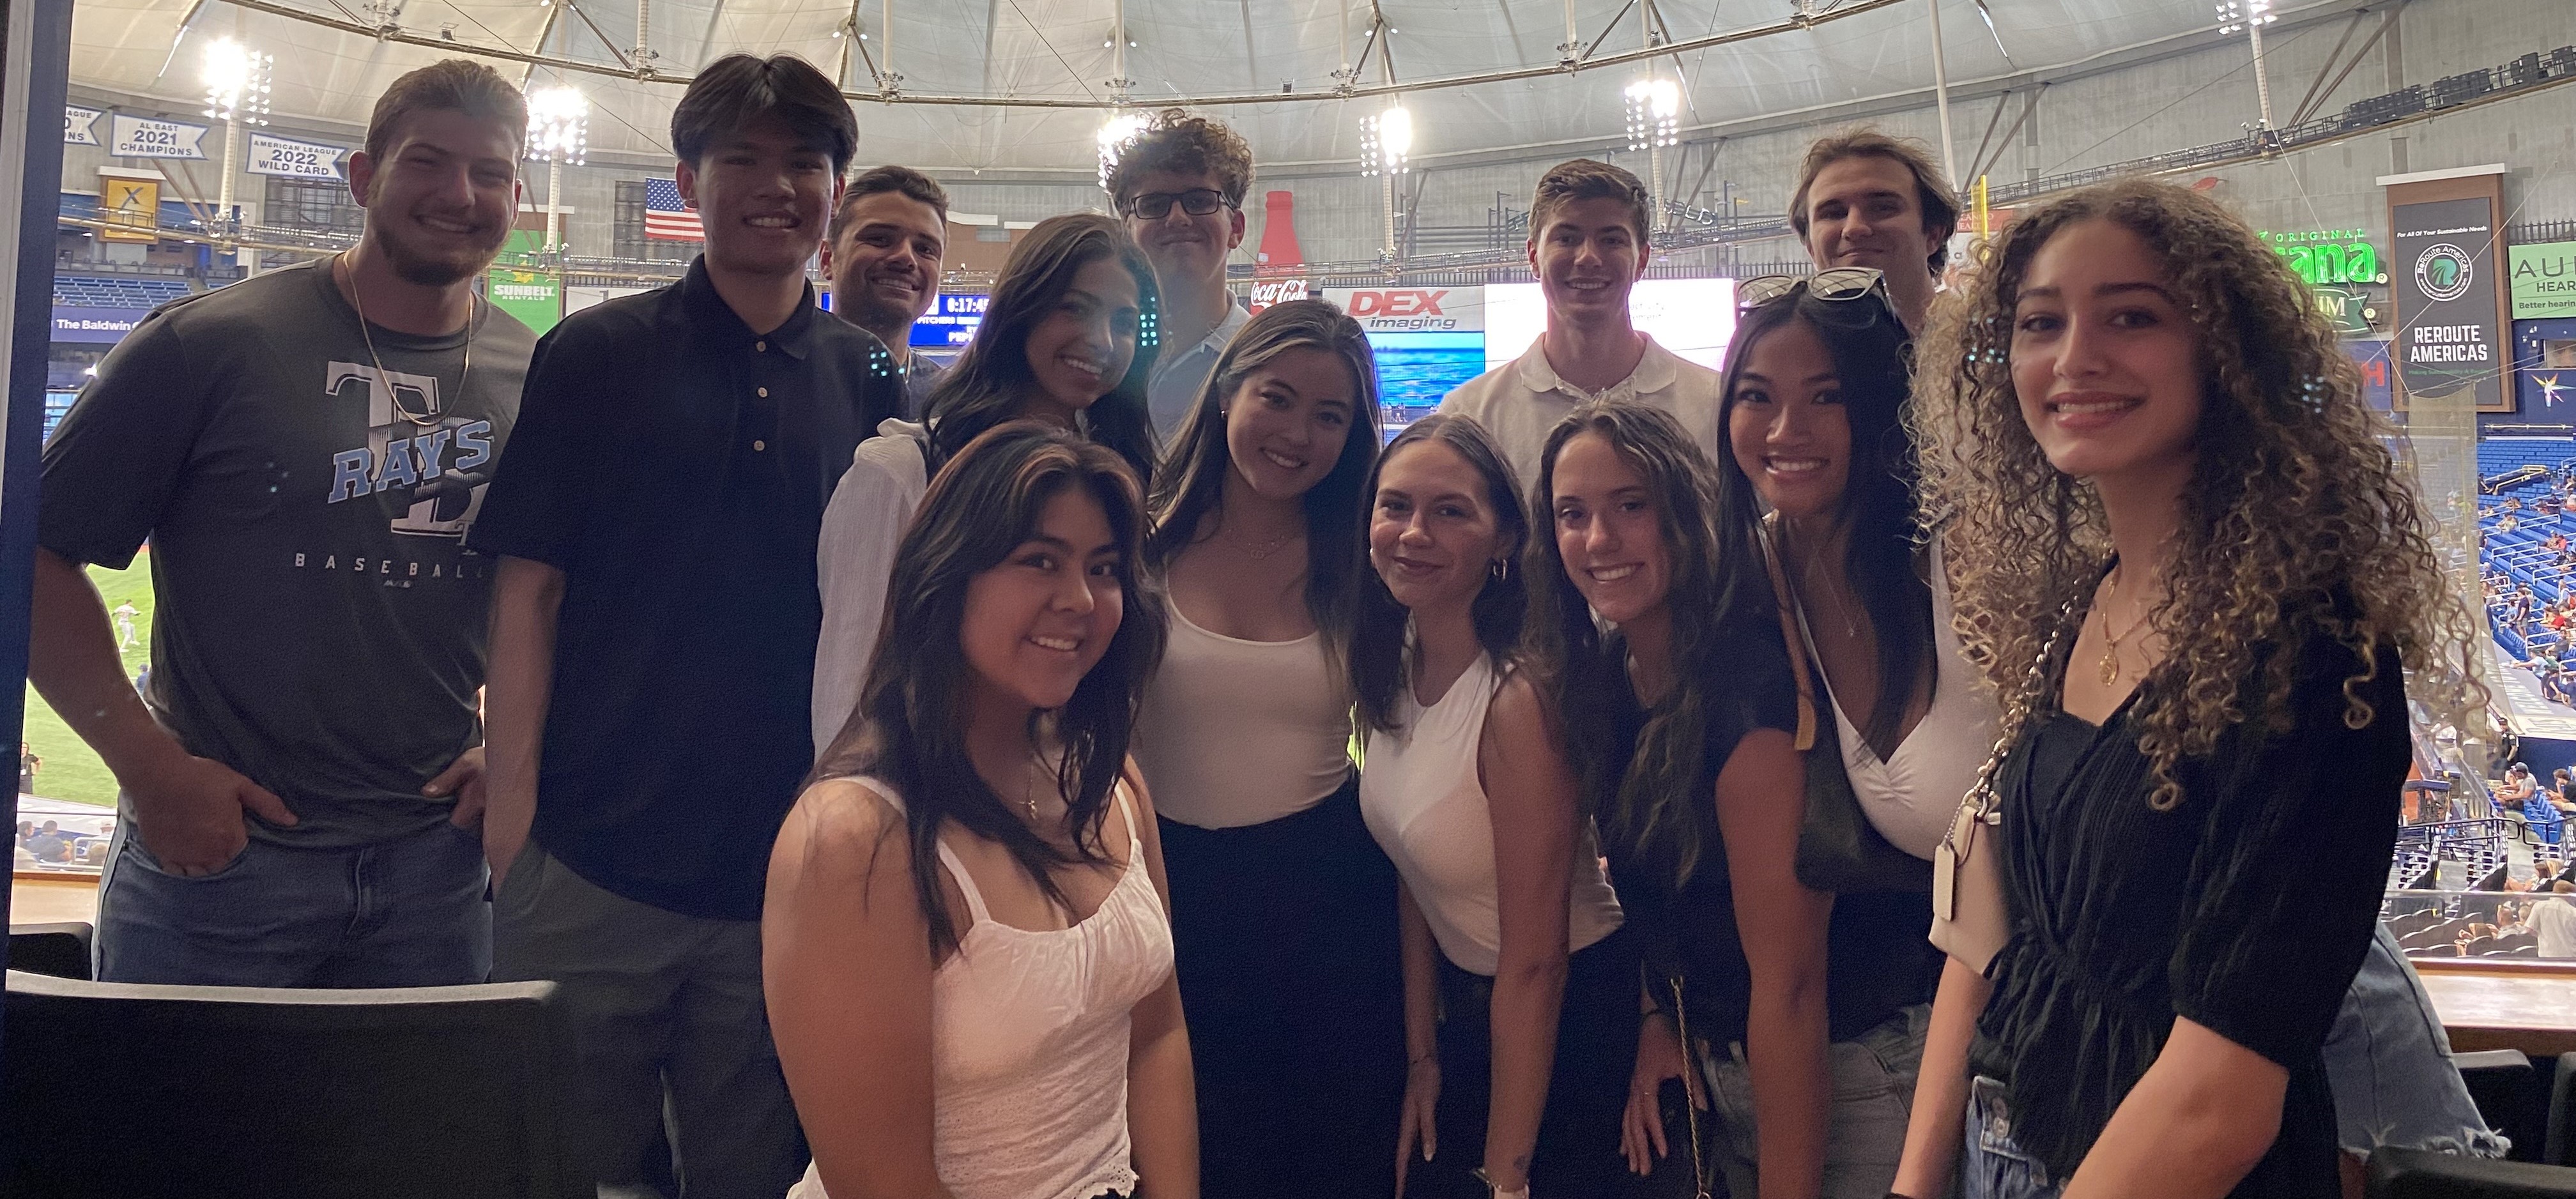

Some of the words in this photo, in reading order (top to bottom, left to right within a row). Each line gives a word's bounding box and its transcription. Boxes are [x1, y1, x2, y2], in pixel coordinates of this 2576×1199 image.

[67, 110, 92, 118] AGUE
[155, 123, 179, 132] EAST
[134, 130, 177, 145] 2021
[120, 142, 192, 156] CHAMPIONS
[254, 141, 300, 151] AMERICAN
[303, 146, 337, 155] LEAGUE
[272, 149, 318, 165] 2022
[258, 160, 289, 171] WILD
[295, 165, 329, 175] CARD
[2276, 228, 2365, 242] ORIGINAL
[2437, 227, 2468, 235] Sustainable
[2417, 247, 2441, 274] ReRoute
[2442, 246, 2469, 273] Americas
[2536, 280, 2576, 292] HEAR
[1251, 279, 1308, 309] Coca-Cola
[1349, 290, 1450, 316] DEX
[56, 319, 80, 329] The
[81, 320, 131, 331] Baldwin
[1370, 316, 1457, 330] imaging
[2414, 325, 2481, 344] REROUTE
[2410, 344, 2488, 362] AMERICAS
[328, 420, 491, 504] RAYS
